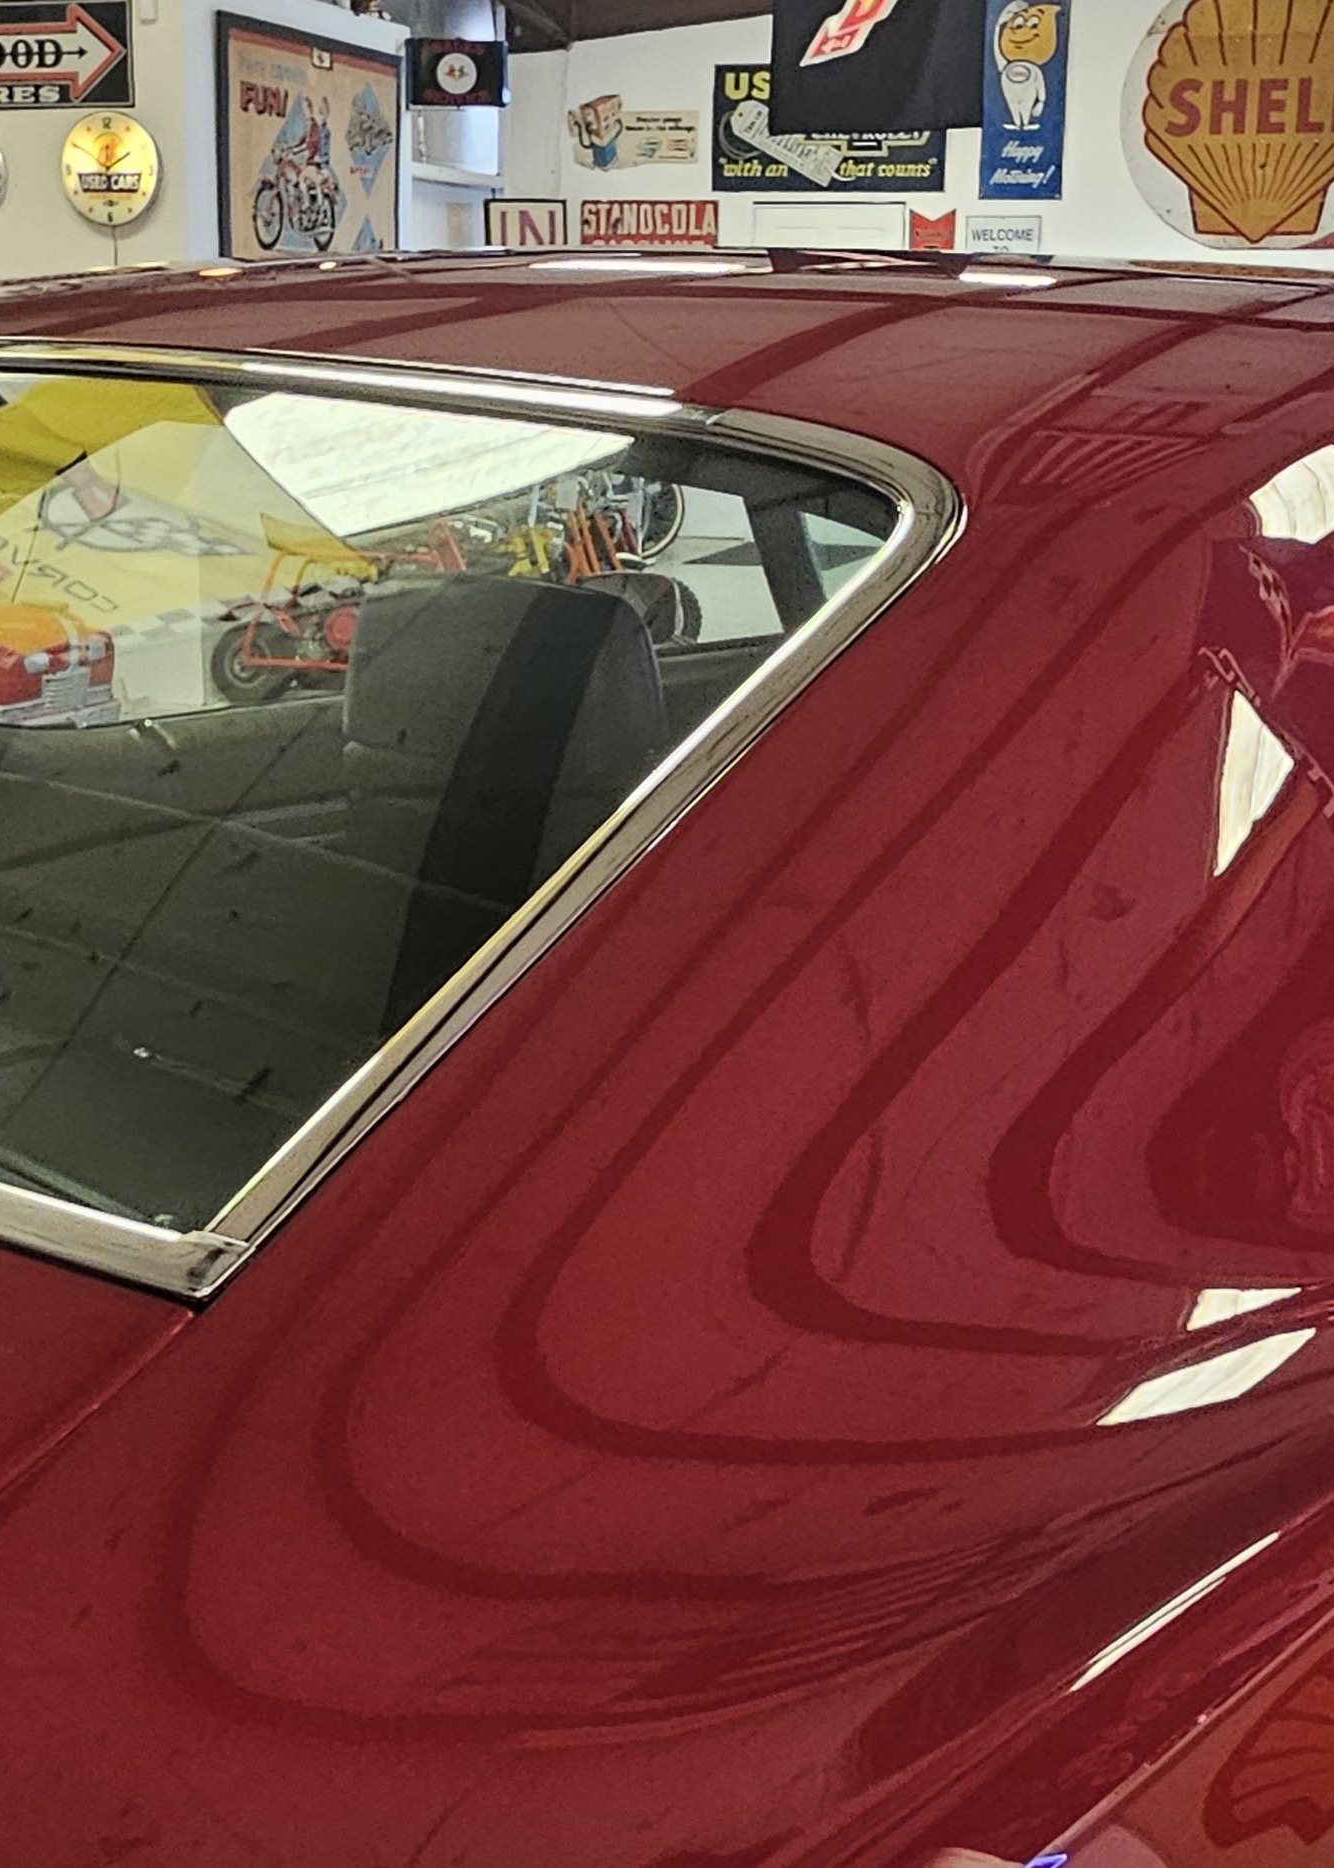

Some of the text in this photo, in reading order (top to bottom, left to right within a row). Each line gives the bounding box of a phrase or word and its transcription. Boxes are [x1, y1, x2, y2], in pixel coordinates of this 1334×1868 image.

[765, 163, 789, 178] an
[839, 159, 874, 178] that
[583, 202, 717, 236] STANOCOLA
[972, 228, 1034, 242] WELCOME
